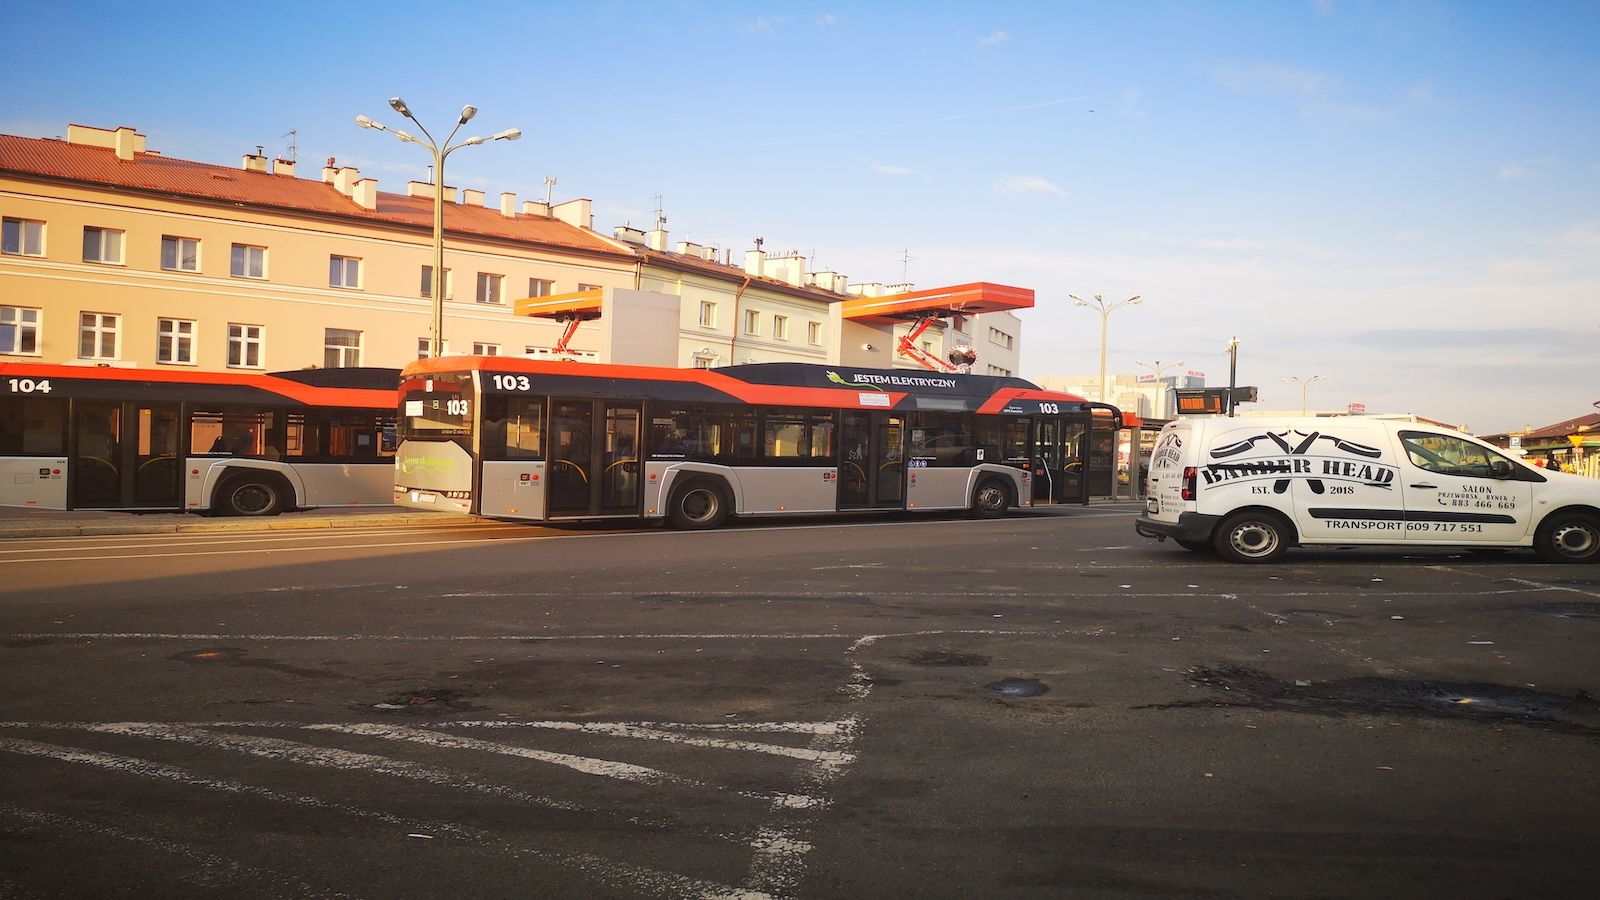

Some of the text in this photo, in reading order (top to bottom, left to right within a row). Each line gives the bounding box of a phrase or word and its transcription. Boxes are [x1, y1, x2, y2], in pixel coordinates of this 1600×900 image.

[8, 378, 52, 394] 104
[493, 375, 531, 391] 103
[853, 374, 956, 388] JESTEM ELEKTRYCZNY
[446, 399, 468, 416] 103
[1039, 402, 1059, 415] 103
[1201, 458, 1394, 485] BARBER HEAD
[1252, 486, 1354, 495] EST. 2018
[1462, 485, 1492, 494] SALON
[1452, 499, 1516, 509] 883 466 669
[1324, 520, 1482, 532] TRANSPORT 609 717 551
